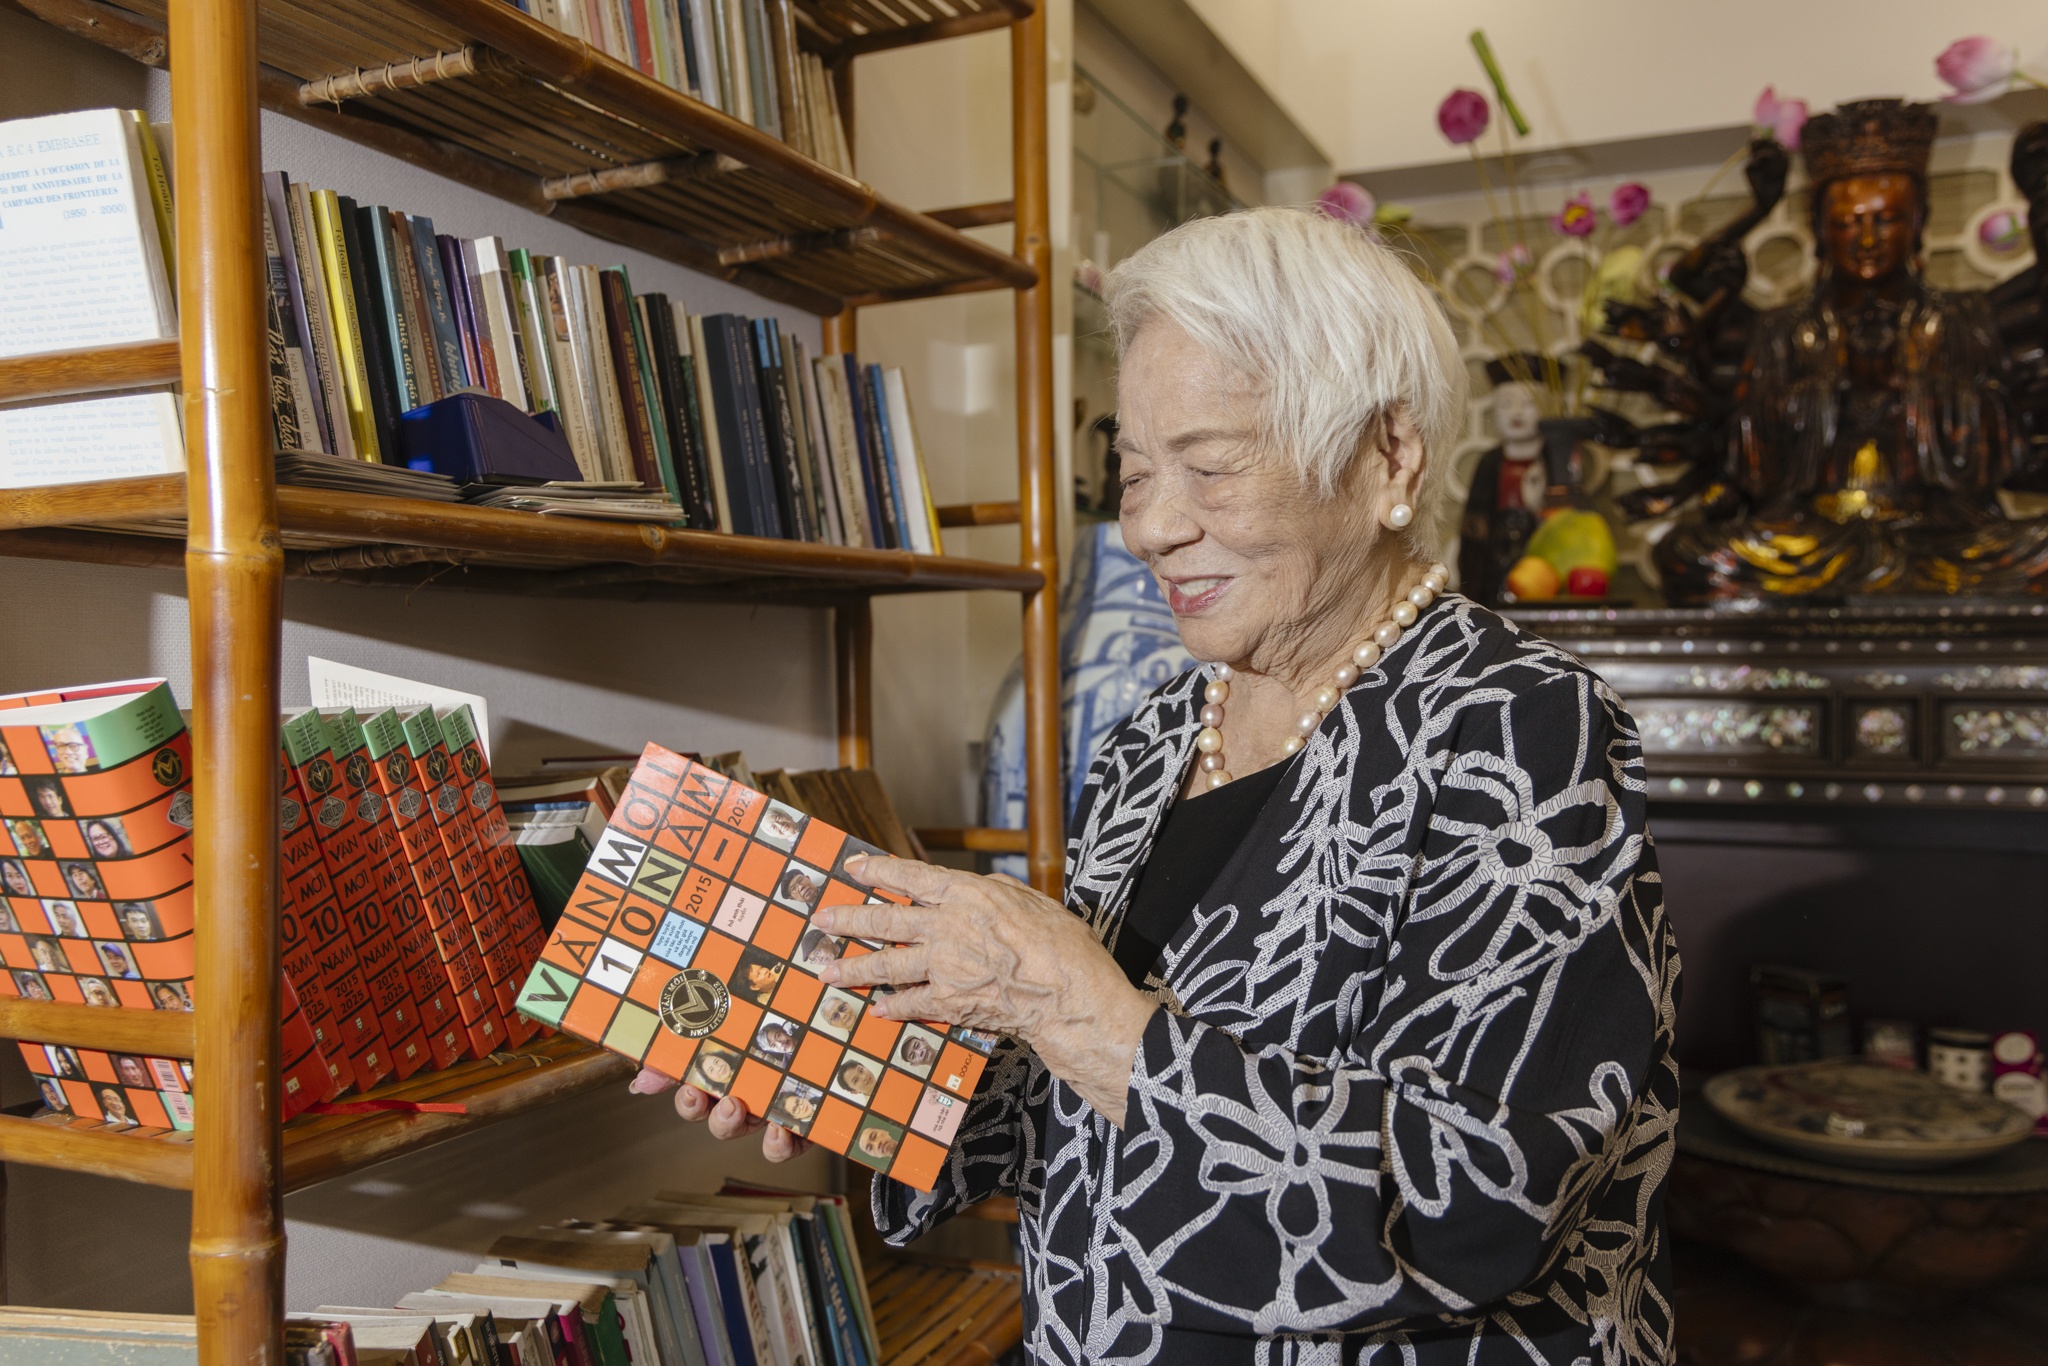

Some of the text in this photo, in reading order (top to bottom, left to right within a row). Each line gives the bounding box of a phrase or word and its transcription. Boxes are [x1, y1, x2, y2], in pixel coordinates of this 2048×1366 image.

[93, 159, 105, 168] DE
[108, 157, 120, 166] LA
[95, 173, 108, 182] DE
[111, 171, 122, 180] LA
[45, 193, 61, 203] DES
[397, 313, 409, 348] nhiệt
[408, 824, 435, 850] VĂN
[447, 820, 472, 845] VĂN
[481, 815, 504, 840] VĂN
[283, 837, 315, 865] VĂN
[328, 835, 358, 862] VĂN
[368, 828, 395, 855] VĂN
[686, 788, 754, 914] 2015 2025
[601, 773, 725, 974] 10 NĂM
[432, 887, 457, 920] 10
[470, 881, 494, 913] 10
[503, 874, 525, 907] 10
[309, 905, 339, 942] 10
[353, 902, 380, 937] 10
[392, 893, 418, 928] 10
[512, 908, 538, 935] NĂM
[441, 922, 469, 951] NĂM
[479, 917, 506, 943] NĂM
[526, 884, 619, 1002] VĂN
[363, 938, 393, 969] NĂM
[402, 929, 431, 959] NĂM
[490, 941, 511, 963] 2015
[523, 934, 543, 954] 2015
[320, 944, 353, 975] NĂM
[415, 956, 437, 980] 2015
[454, 949, 475, 971] 2015
[496, 956, 516, 977] 2025
[334, 974, 359, 998] 2015
[376, 966, 399, 991] 2015
[420, 973, 442, 995] 2025
[459, 965, 480, 986] 2025
[340, 992, 364, 1014] 2025
[382, 982, 405, 1007] 2025
